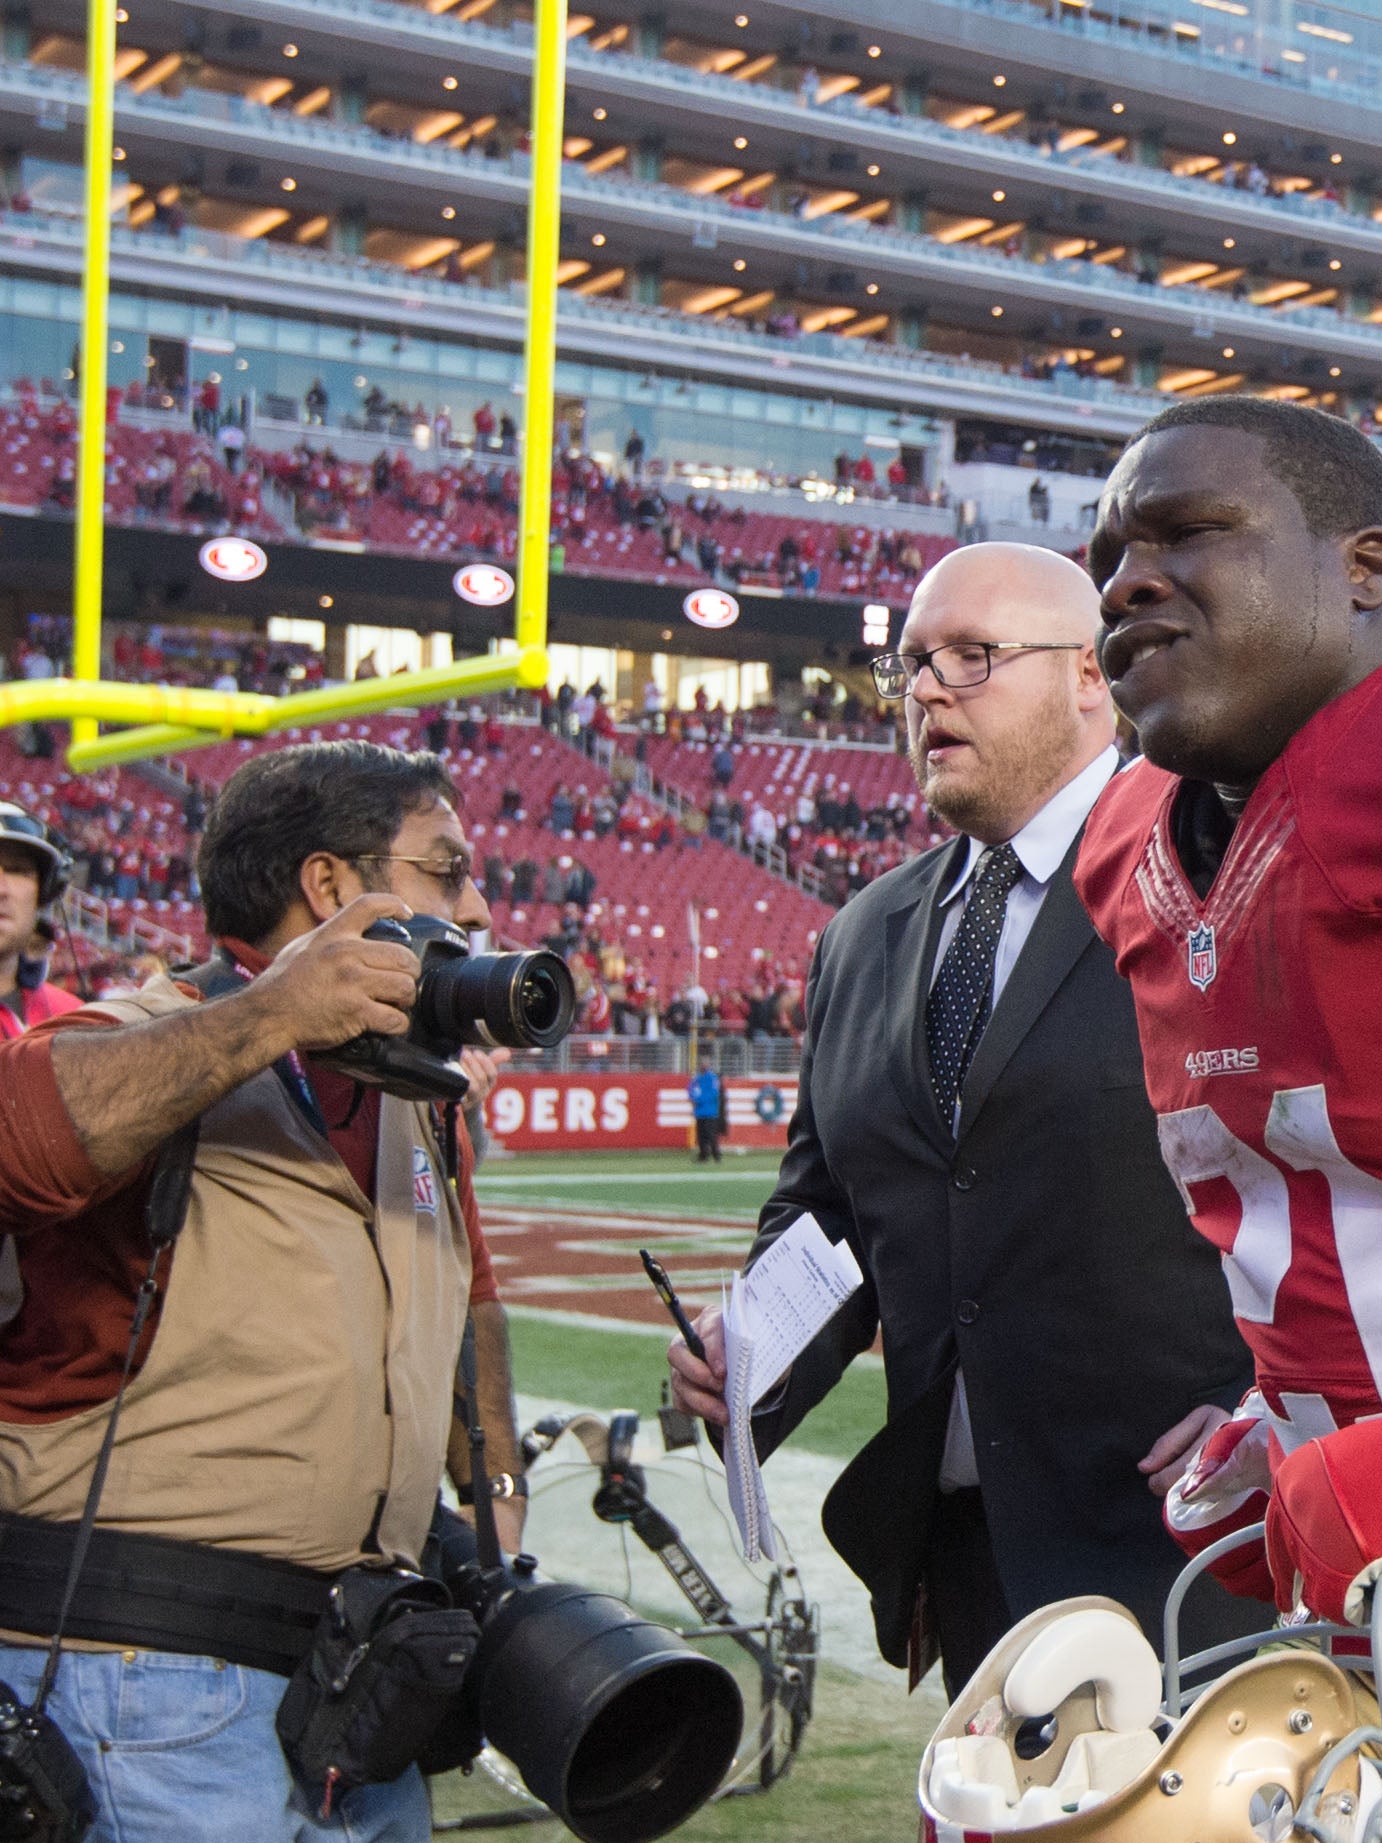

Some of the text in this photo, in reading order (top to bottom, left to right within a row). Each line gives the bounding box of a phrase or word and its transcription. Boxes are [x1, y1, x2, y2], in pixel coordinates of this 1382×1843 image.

[1193, 951, 1213, 979] NFL
[1185, 1046, 1260, 1079] 49ERS
[484, 1086, 630, 1134] 9ERS
